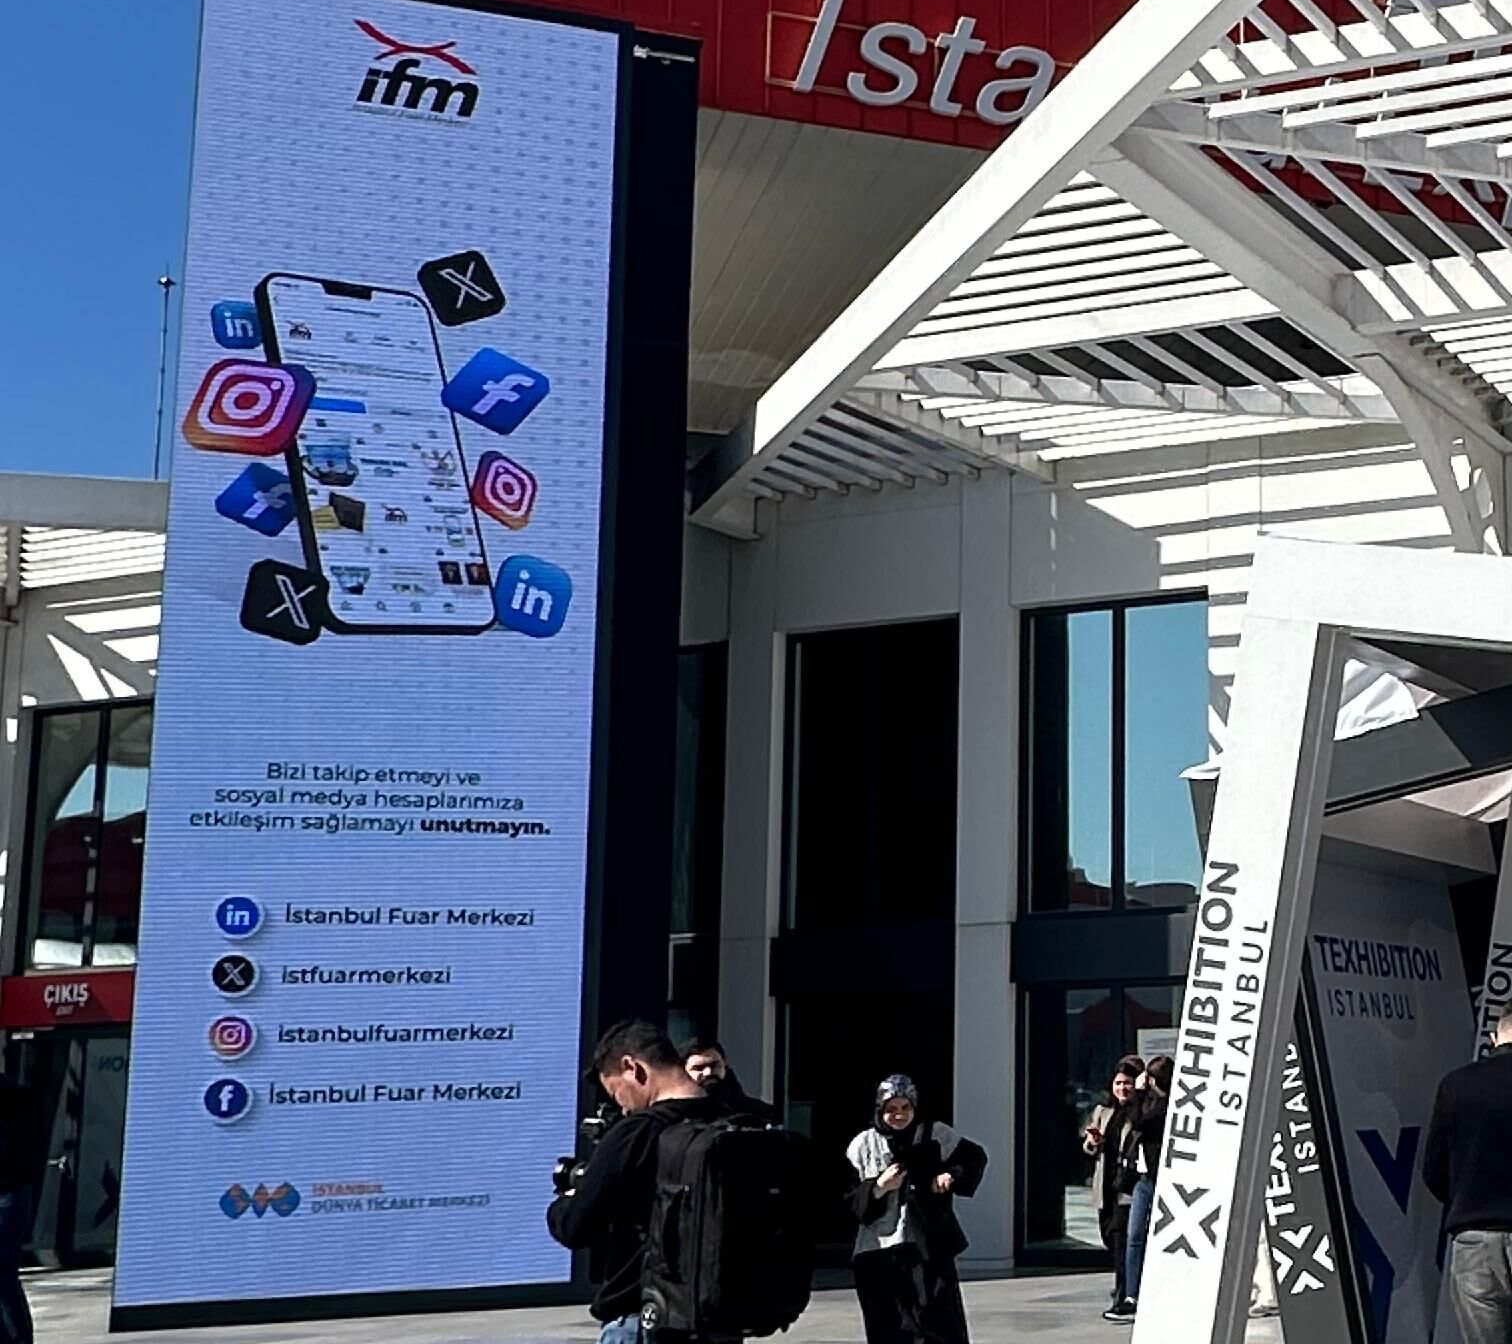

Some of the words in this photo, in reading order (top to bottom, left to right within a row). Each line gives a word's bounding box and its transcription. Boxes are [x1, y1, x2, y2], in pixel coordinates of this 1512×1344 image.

[356, 58, 479, 117] ifm
[267, 761, 306, 780] Bizi
[312, 764, 370, 785] takip
[374, 767, 450, 788] etmeyi
[456, 771, 482, 786] ve
[214, 786, 284, 807] sosyal
[290, 788, 368, 810] medya
[189, 810, 295, 832] etkileşim
[420, 818, 552, 838] unutmayın.
[388, 907, 440, 926] Fuar
[446, 907, 535, 927] Merkezi
[1313, 935, 1443, 982] TEXHIBITION
[281, 965, 452, 985] istfuarmerkezi
[44, 982, 90, 1009] ÇIKIŞ
[1327, 988, 1416, 1021] ISTANBUL
[1165, 860, 1240, 1169] TEXHIBITION
[1216, 920, 1268, 1127] ISTANBUL
[278, 1023, 515, 1043] istanbulfuarmerkezi
[373, 1084, 426, 1102] Fuar
[432, 1081, 522, 1101] Merkezi
[1281, 1041, 1321, 1174] ISTAN
